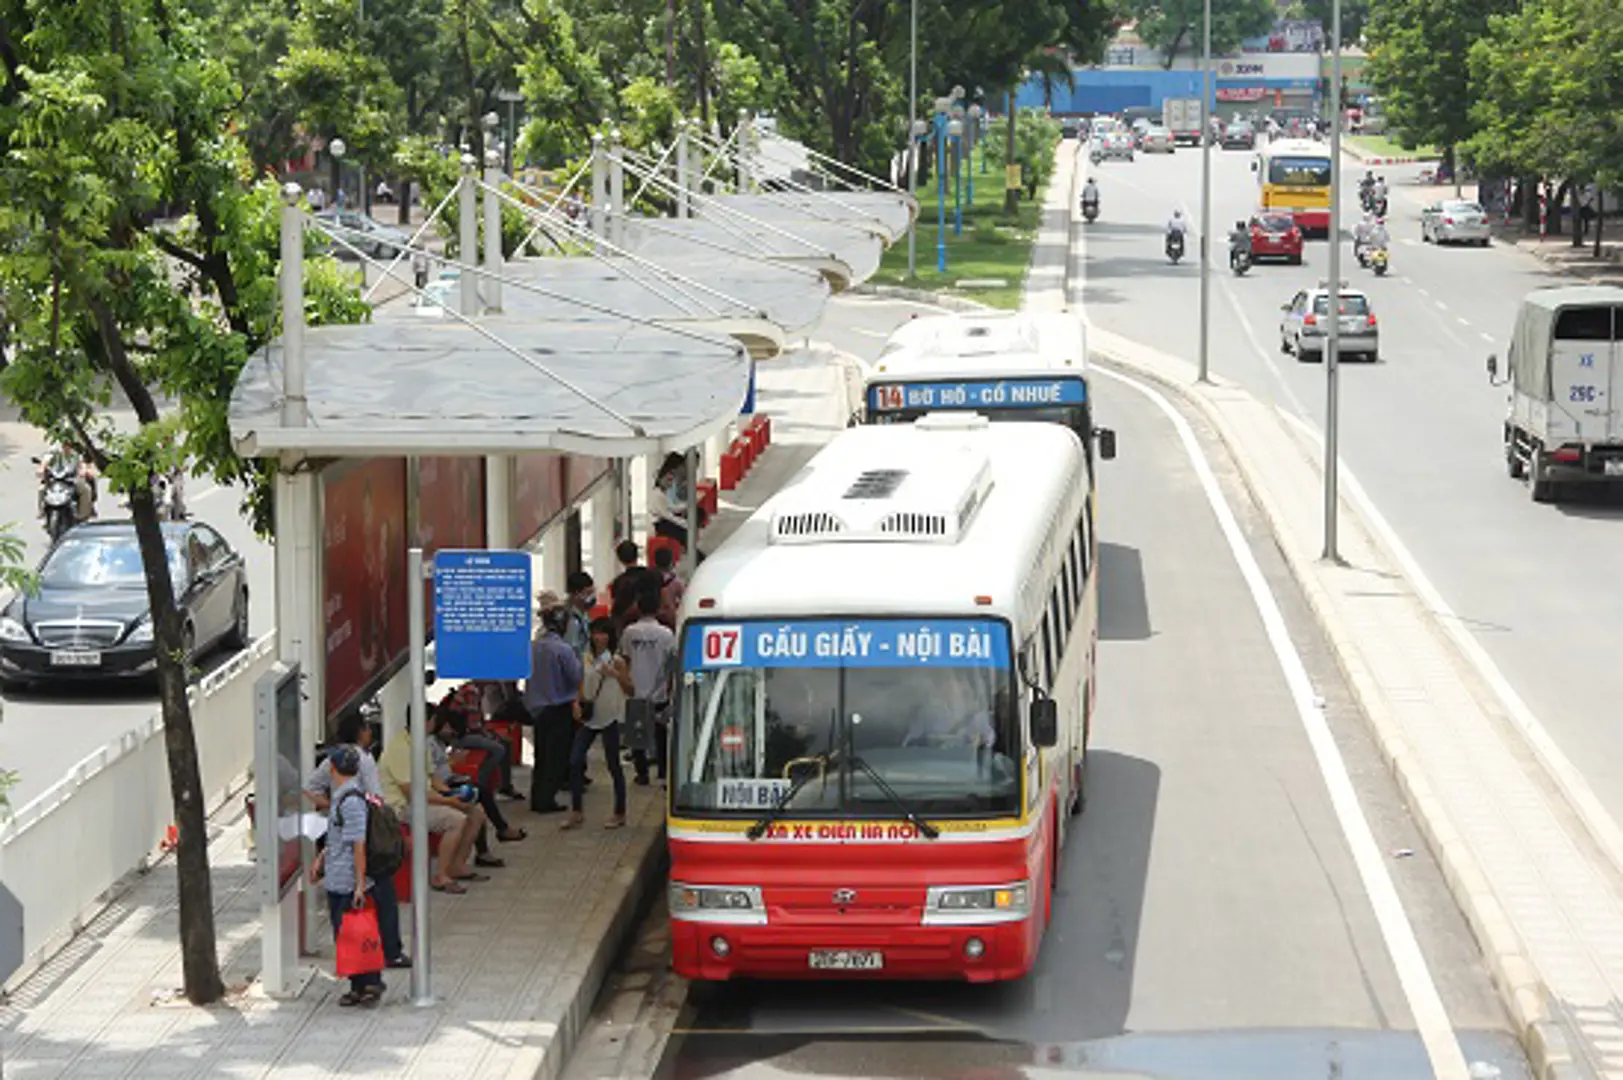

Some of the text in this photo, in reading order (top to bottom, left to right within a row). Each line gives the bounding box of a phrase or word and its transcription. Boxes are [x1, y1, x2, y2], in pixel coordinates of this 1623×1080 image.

[878, 387, 902, 407] 14
[706, 630, 739, 659] 07
[815, 624, 873, 657] GIẤY
[897, 626, 941, 662] NỘI
[949, 627, 991, 658] BÀI
